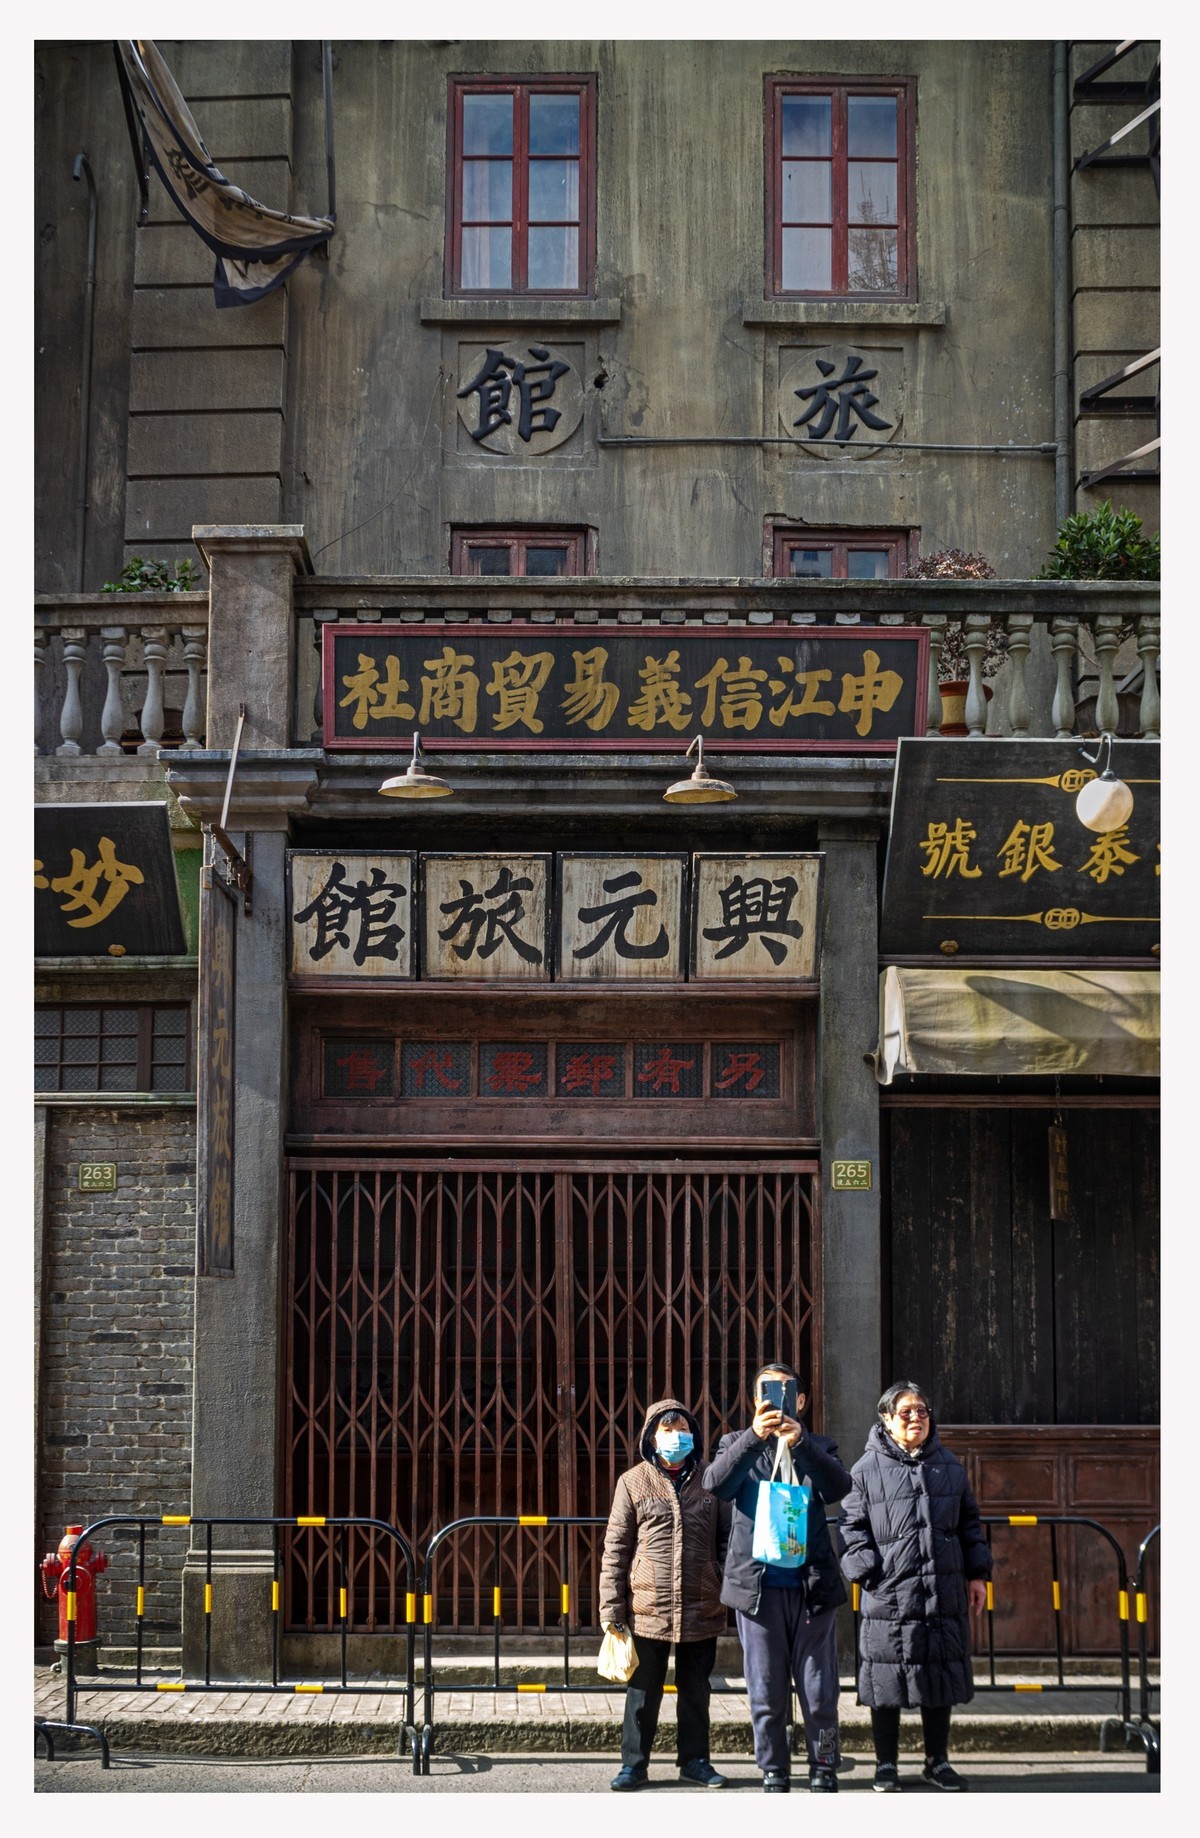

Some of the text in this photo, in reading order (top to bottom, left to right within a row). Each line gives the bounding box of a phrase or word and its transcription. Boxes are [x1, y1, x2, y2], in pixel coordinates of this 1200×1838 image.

[34, 836, 145, 928] 妙
[919, 818, 1160, 882] 泰銀號
[293, 861, 804, 966] 興元旅館
[83, 1166, 112, 1180] 263
[837, 1164, 867, 1178] 265
